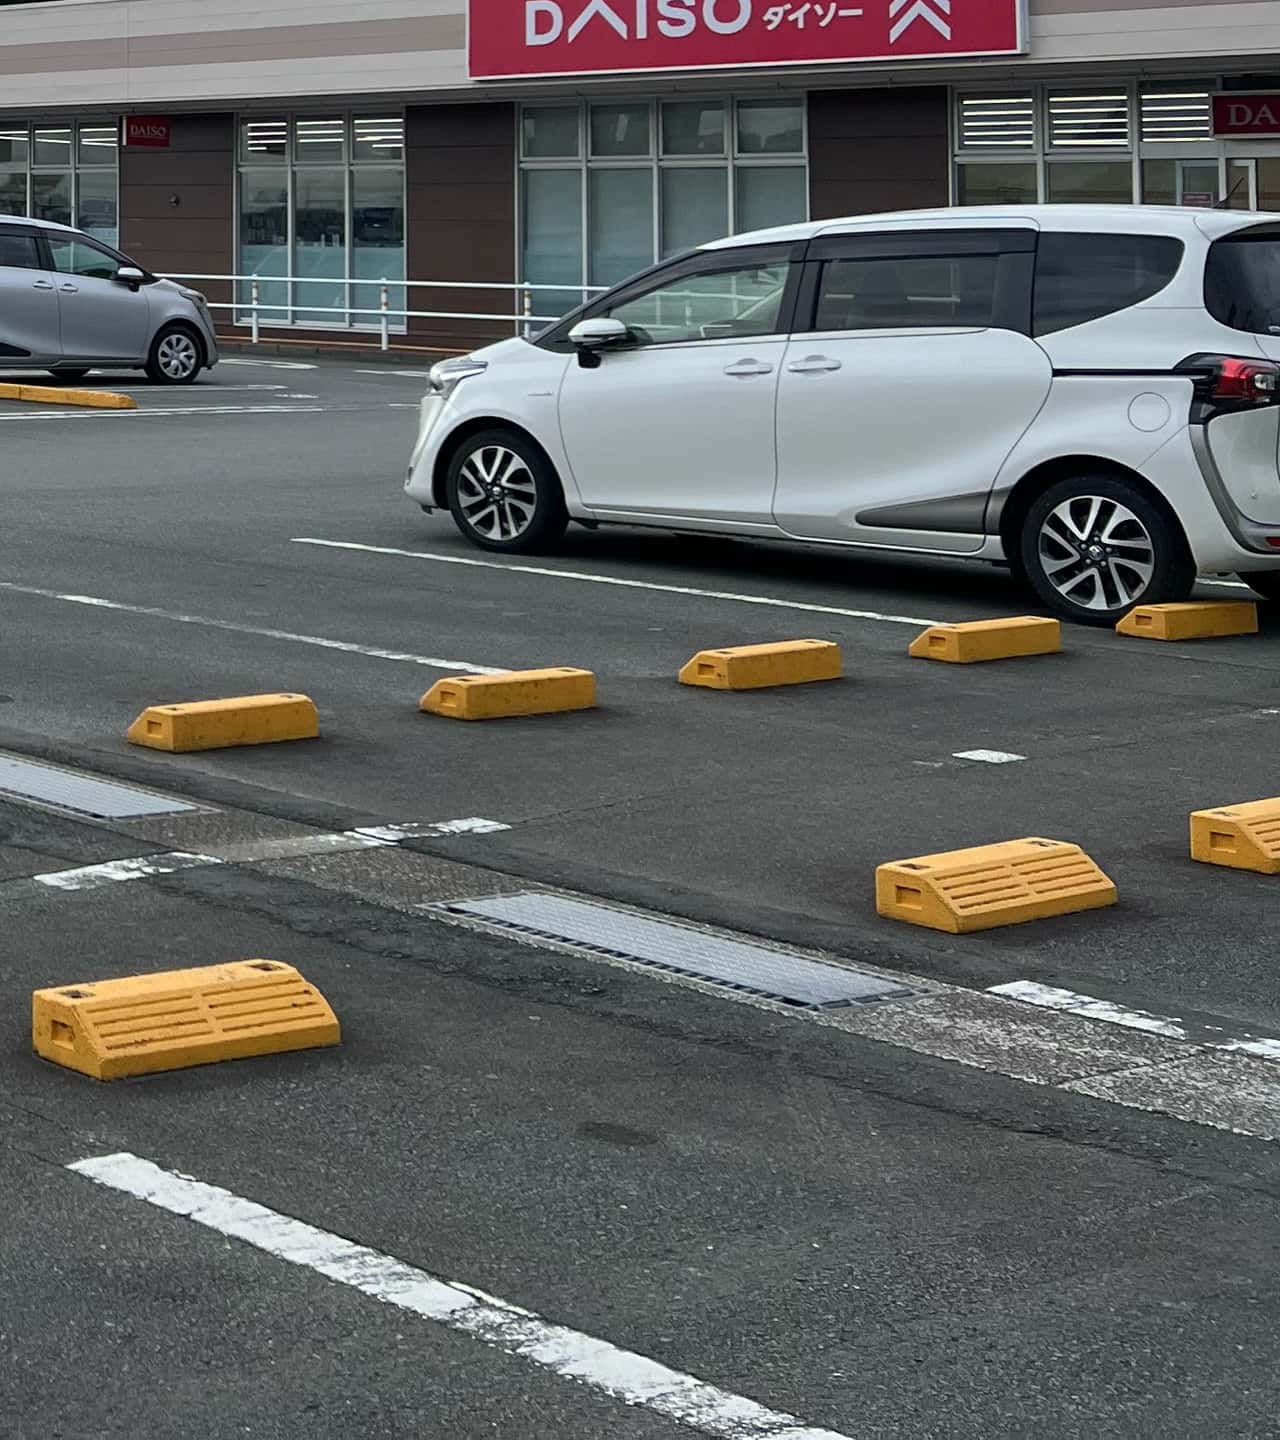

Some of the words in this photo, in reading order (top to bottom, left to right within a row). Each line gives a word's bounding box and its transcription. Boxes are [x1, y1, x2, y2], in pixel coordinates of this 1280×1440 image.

[762, 2, 863, 30] ダイソー
[130, 124, 167, 136] DAISO
